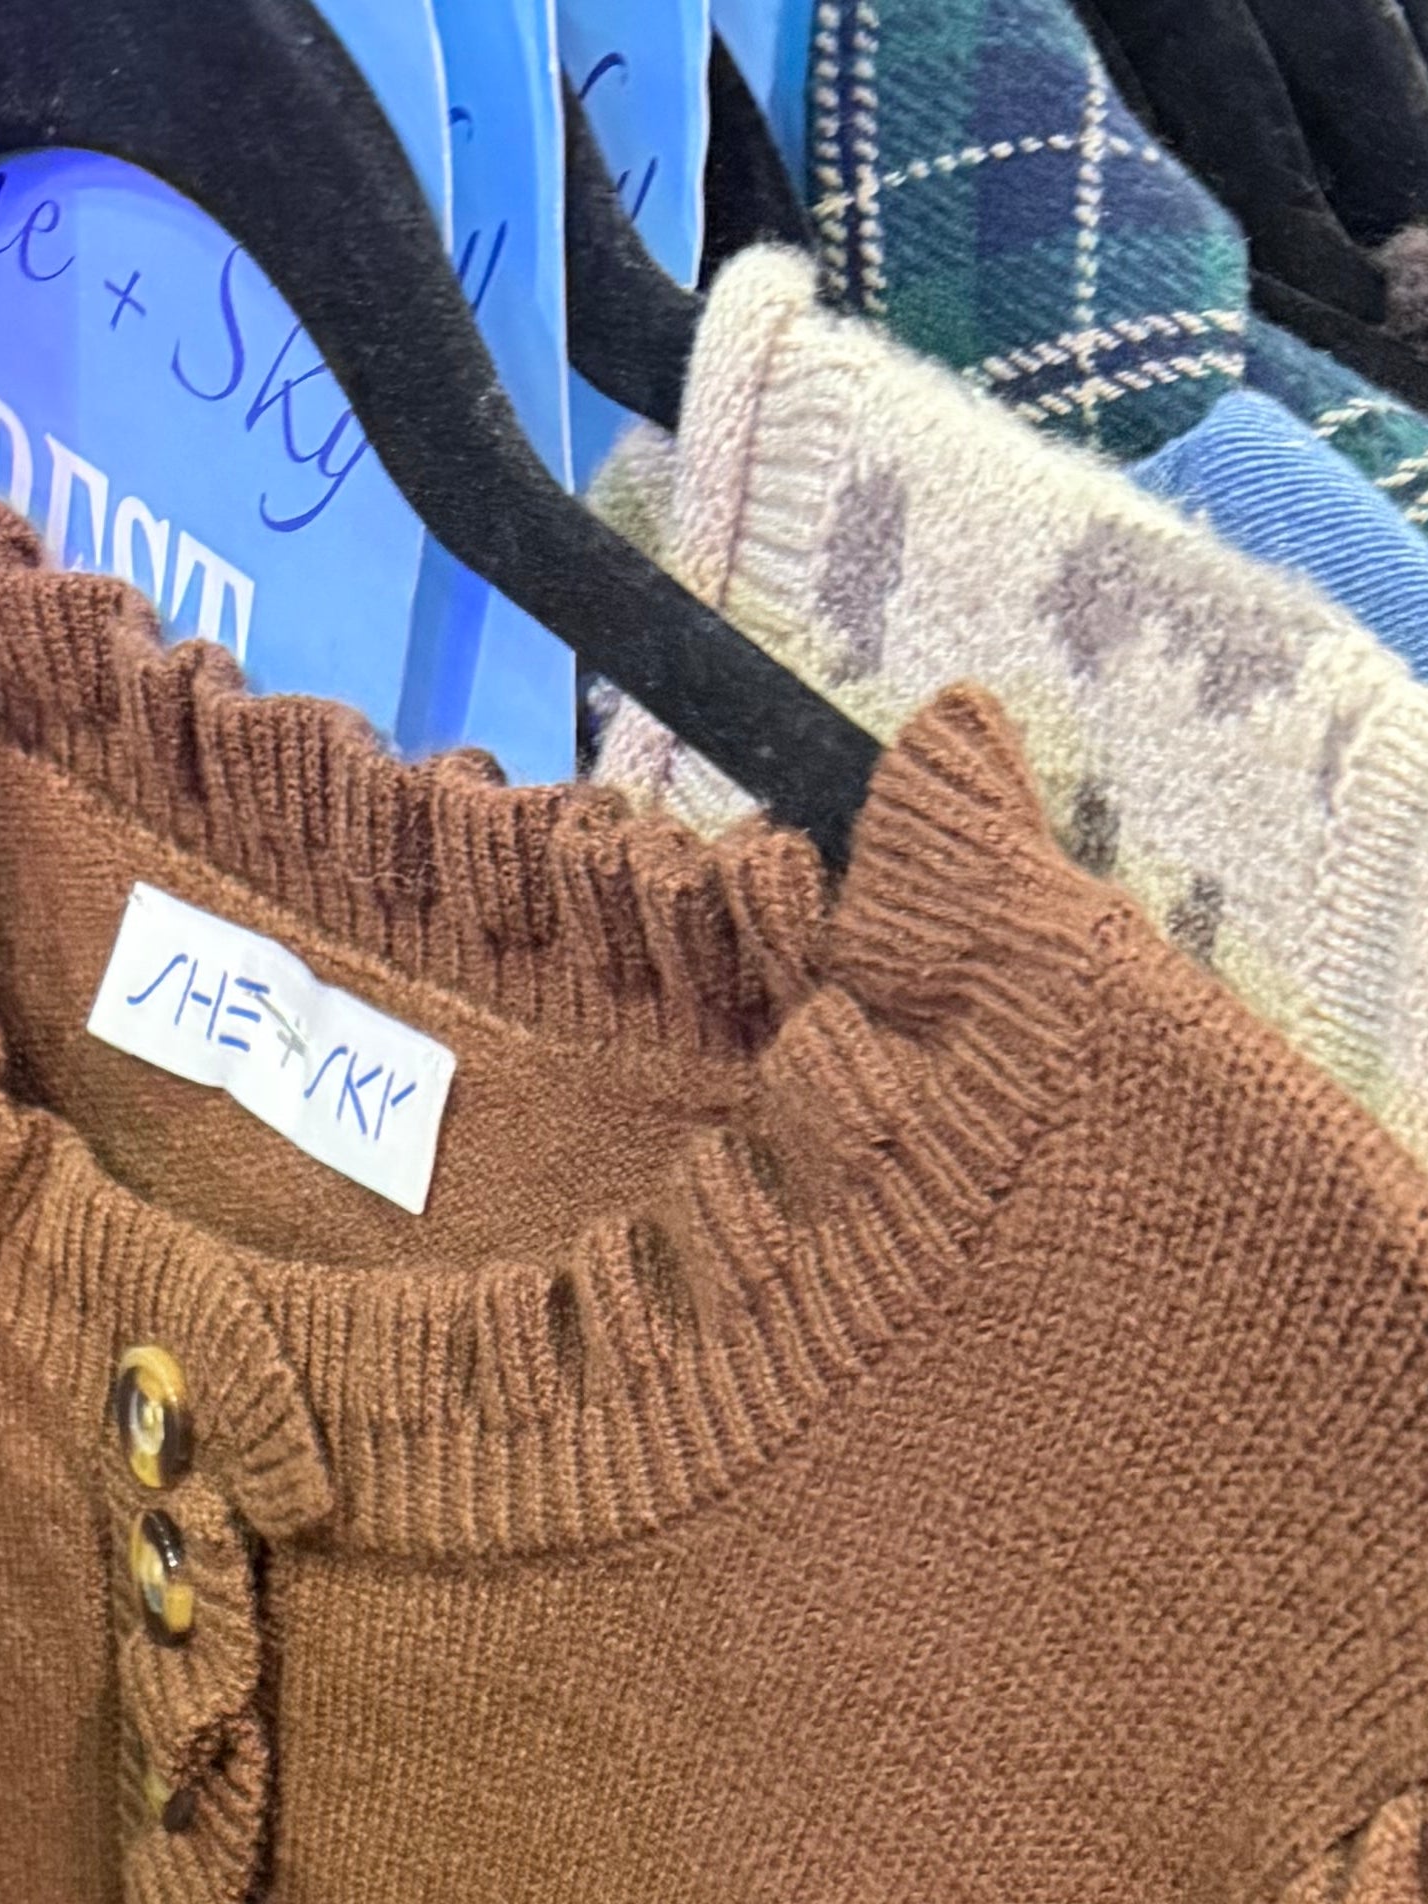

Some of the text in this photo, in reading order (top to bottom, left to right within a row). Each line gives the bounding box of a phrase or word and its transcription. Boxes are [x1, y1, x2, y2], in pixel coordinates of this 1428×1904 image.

[104, 270, 146, 331] +
[171, 241, 370, 533] Sky
[126, 953, 270, 1052] SHE
[303, 1045, 417, 1141] SKY
